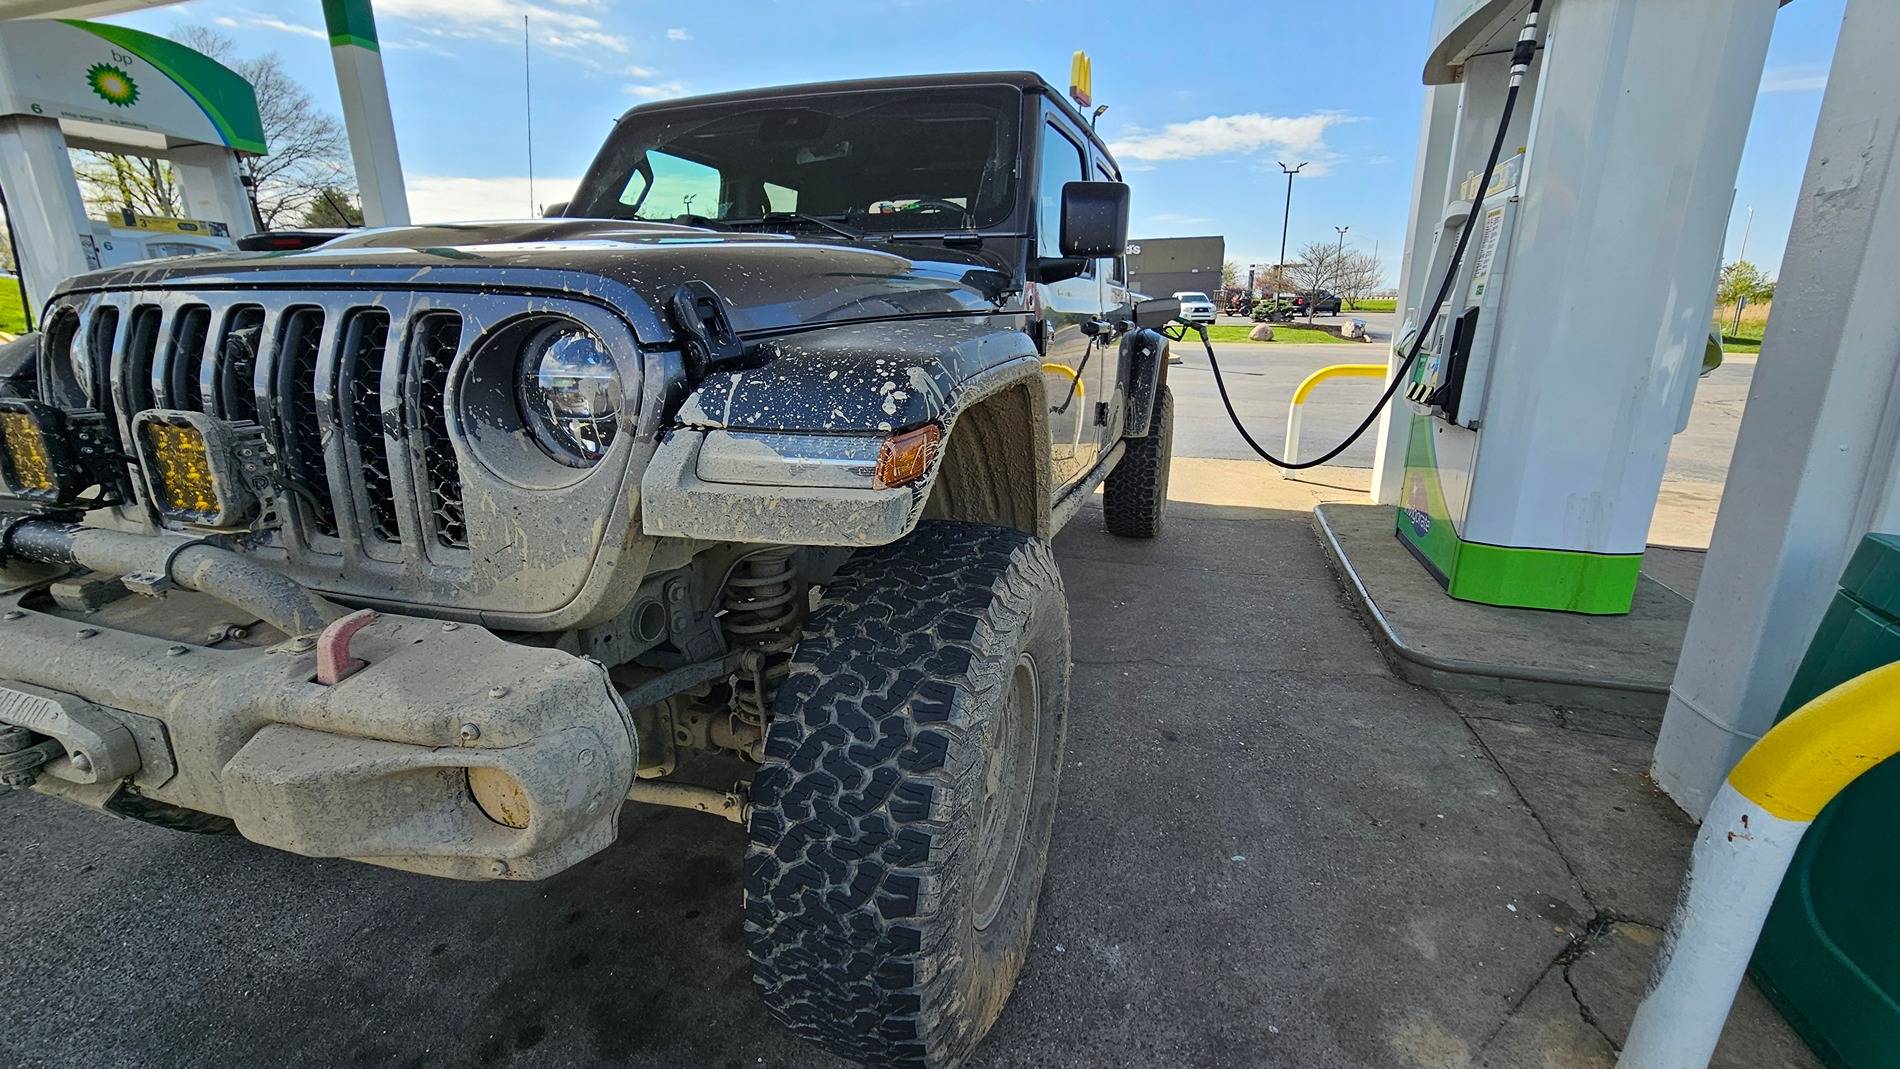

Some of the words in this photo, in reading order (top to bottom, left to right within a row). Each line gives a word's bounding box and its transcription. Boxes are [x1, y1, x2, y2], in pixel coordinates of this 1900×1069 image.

[111, 49, 133, 66] bp
[30, 103, 43, 114] 6
[103, 241, 113, 251] 6
